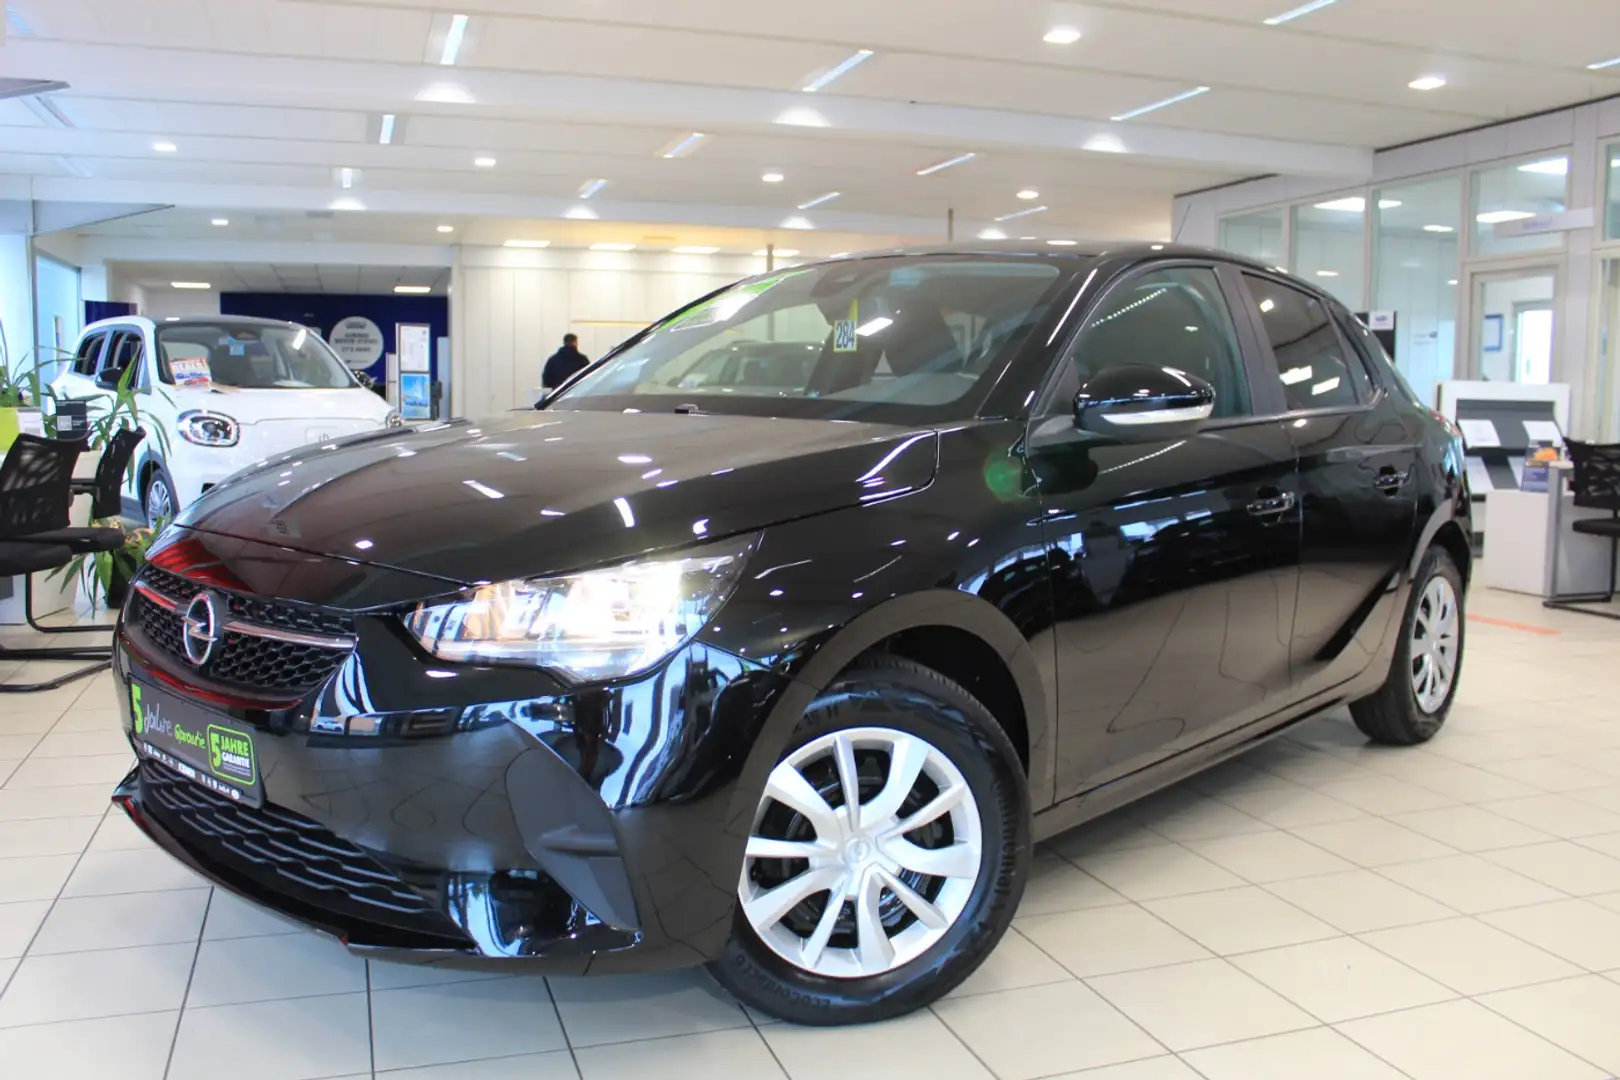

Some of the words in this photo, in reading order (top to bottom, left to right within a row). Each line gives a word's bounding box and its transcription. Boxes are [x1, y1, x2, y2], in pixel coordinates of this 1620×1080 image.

[835, 319, 855, 349] 284
[131, 683, 143, 734] 5
[210, 732, 222, 768] 5
[220, 735, 250, 757] JAHRE
[221, 751, 251, 768] GARANTIE
